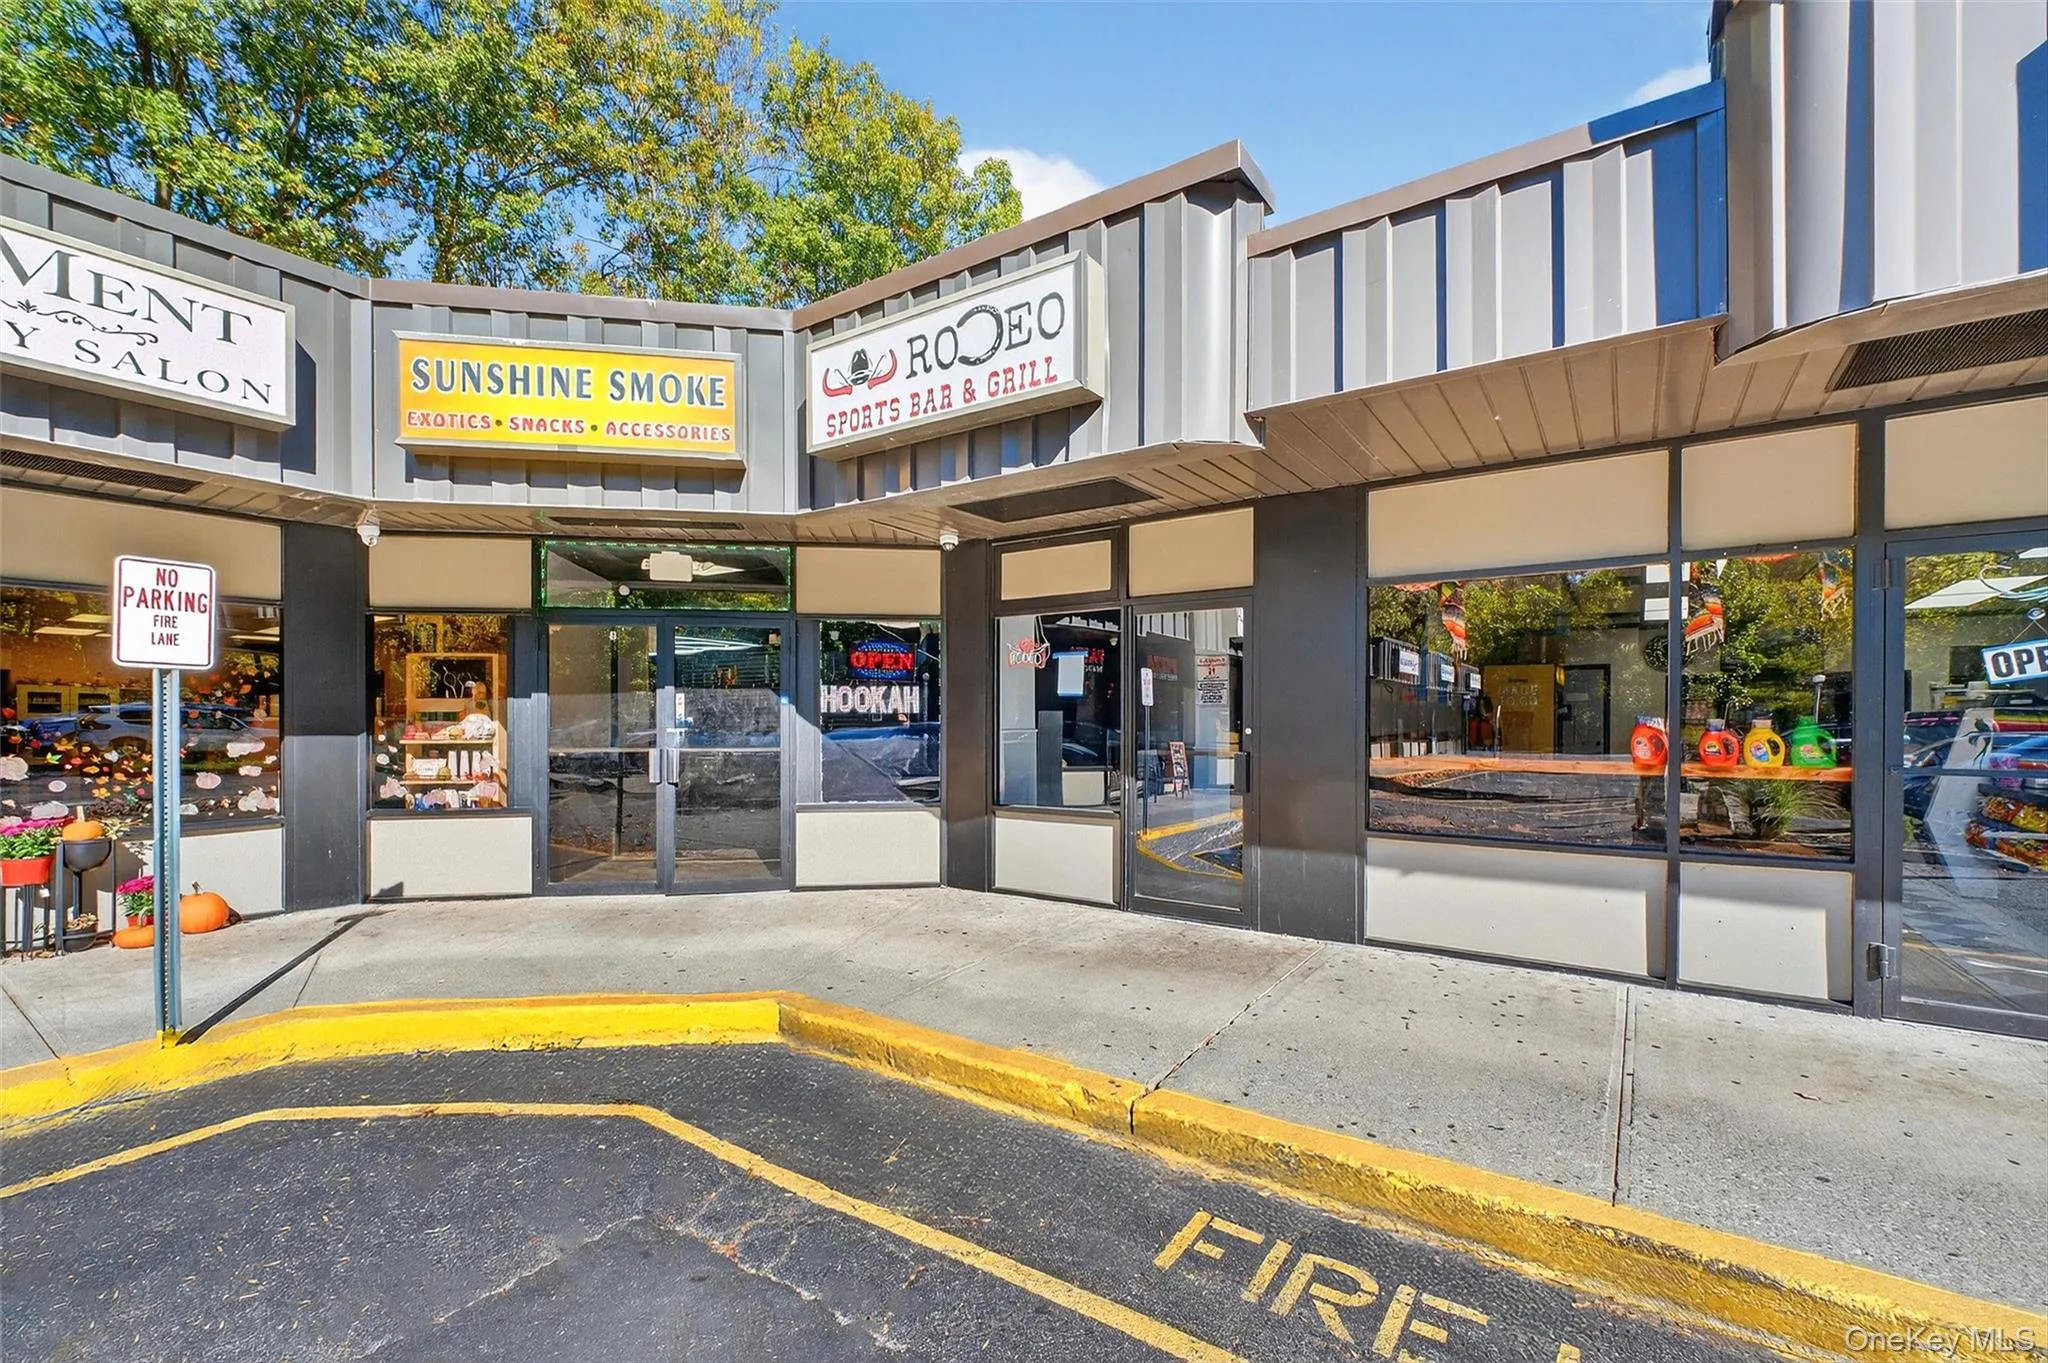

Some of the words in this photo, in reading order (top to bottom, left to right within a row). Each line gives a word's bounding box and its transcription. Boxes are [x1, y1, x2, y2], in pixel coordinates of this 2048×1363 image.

[74, 338, 272, 406] SALON
[411, 358, 593, 400] SUNSHINE
[609, 370, 727, 408] SMOKE
[826, 396, 902, 438] SPORTS
[909, 383, 954, 418] BAR
[963, 378, 977, 404] &
[987, 356, 1058, 398] GRILL
[406, 411, 492, 430] EXOTICS
[508, 416, 586, 434] SNACKS
[605, 421, 732, 442] ACCESSORIES
[155, 567, 179, 588] NO
[122, 585, 208, 614] PARKING
[153, 614, 178, 629] FIRE
[151, 632, 180, 646] LANE
[850, 651, 914, 671] OPEN
[820, 684, 920, 714] HOOKAH
[1153, 1208, 1490, 1363] FIRE
